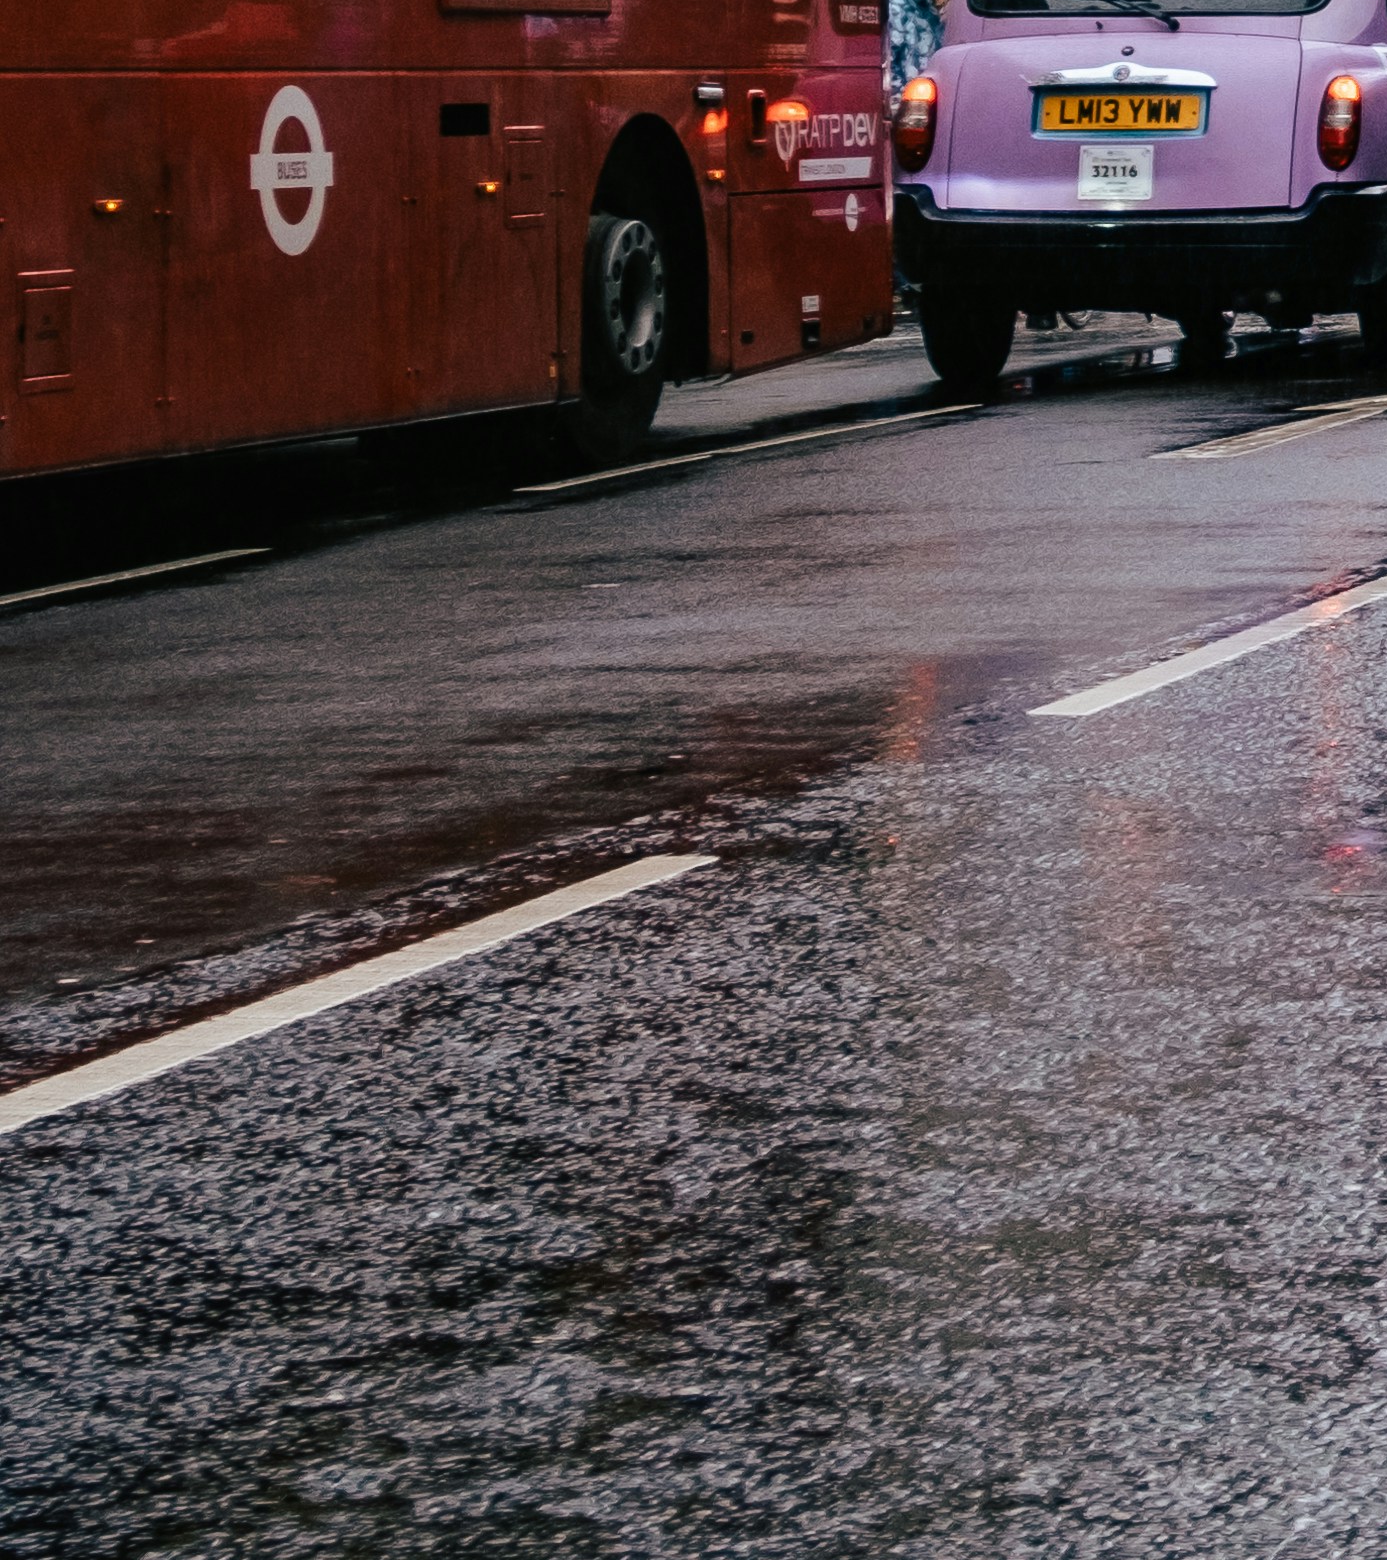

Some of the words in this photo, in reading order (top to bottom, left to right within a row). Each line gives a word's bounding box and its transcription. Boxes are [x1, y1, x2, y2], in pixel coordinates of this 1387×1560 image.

[1059, 99, 1120, 125] LM13
[1128, 97, 1182, 124] YWW
[1091, 164, 1138, 178] 32116
